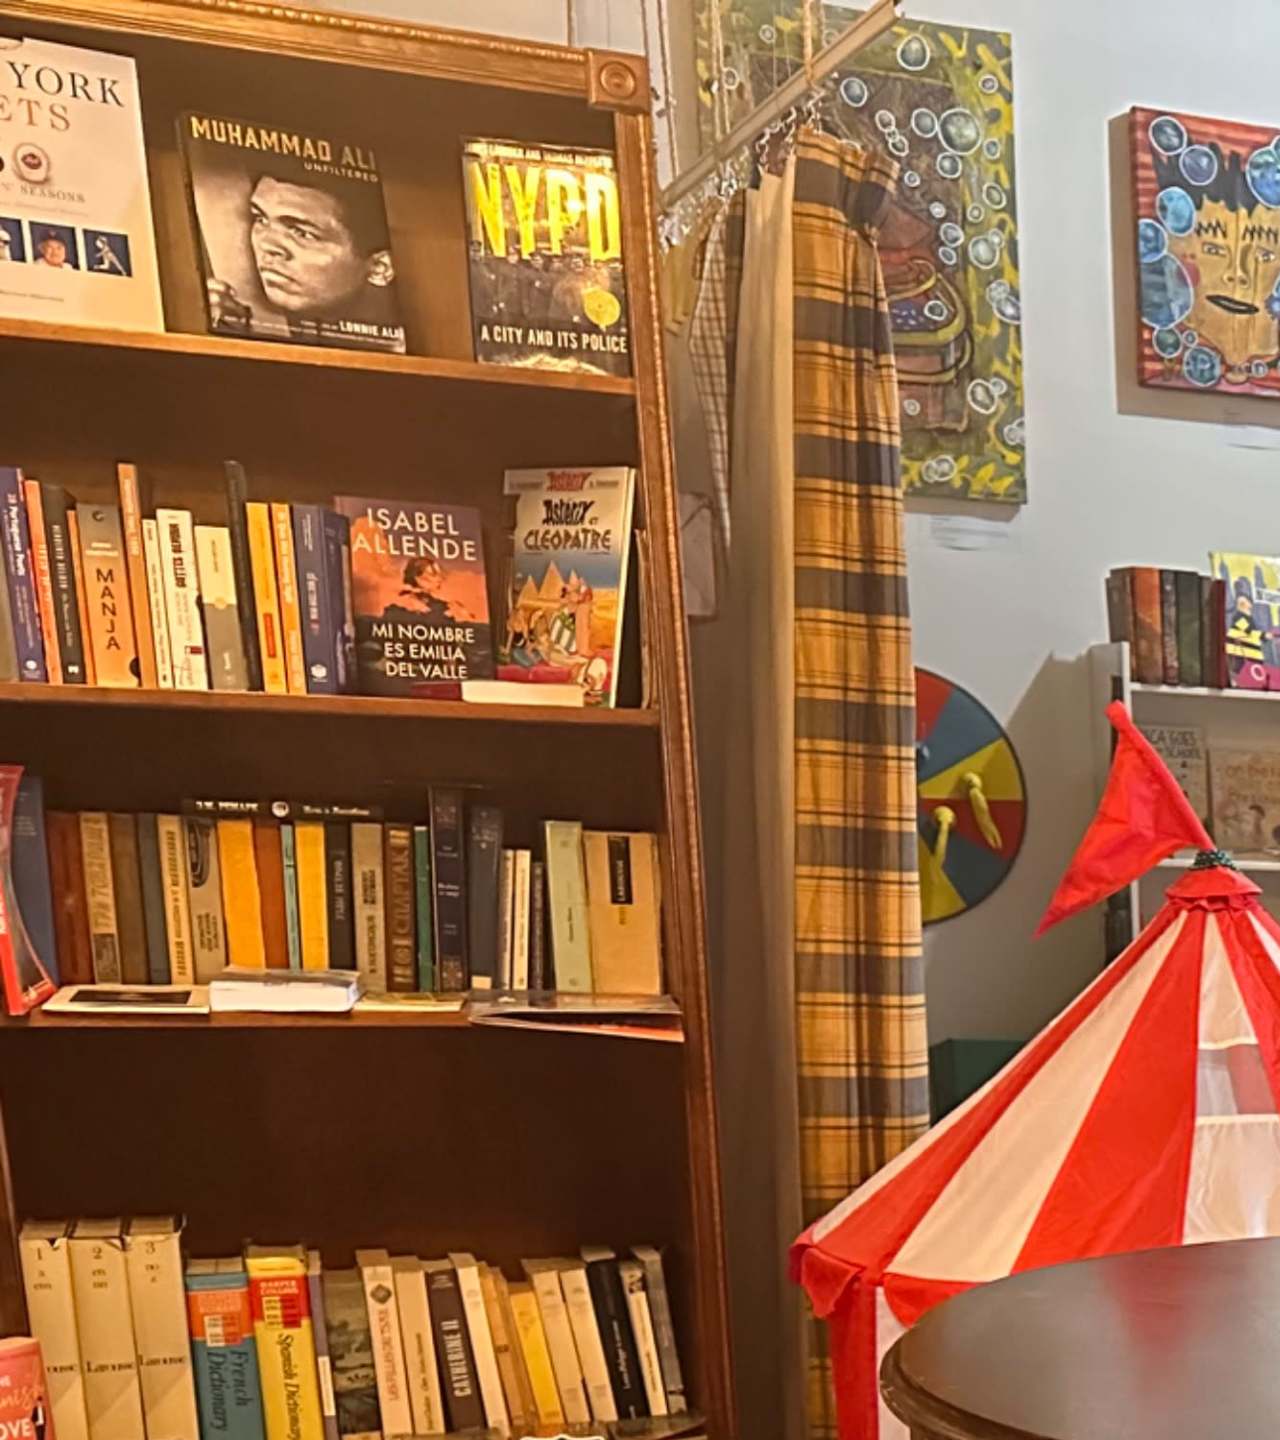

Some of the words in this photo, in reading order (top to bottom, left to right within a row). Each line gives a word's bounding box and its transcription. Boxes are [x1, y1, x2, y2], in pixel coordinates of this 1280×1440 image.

[7, 60, 125, 108] YORK
[190, 116, 332, 162] MUHAMMAD
[340, 146, 377, 170] ALI
[303, 162, 379, 183] UNFILTERED
[468, 160, 622, 263] NYPD
[481, 326, 490, 341] A
[493, 325, 523, 345] CITY
[528, 329, 554, 347] AND
[558, 333, 579, 349] ITS
[582, 333, 628, 353] POLICE
[366, 507, 460, 537] ISABEL
[351, 531, 478, 562] ALLENDE
[95, 568, 121, 651] MANJA
[371, 622, 394, 639] MI
[399, 624, 476, 644] NOMBRE
[383, 642, 406, 659] ES
[409, 643, 467, 662] EMILIA
[385, 661, 417, 678] DEL
[421, 663, 468, 680] VALLE
[230, 1350, 254, 1408] French
[278, 1332, 295, 1380] Spanish
[445, 1331, 472, 1398] CATHERINE
[206, 1352, 228, 1432] Dictionary
